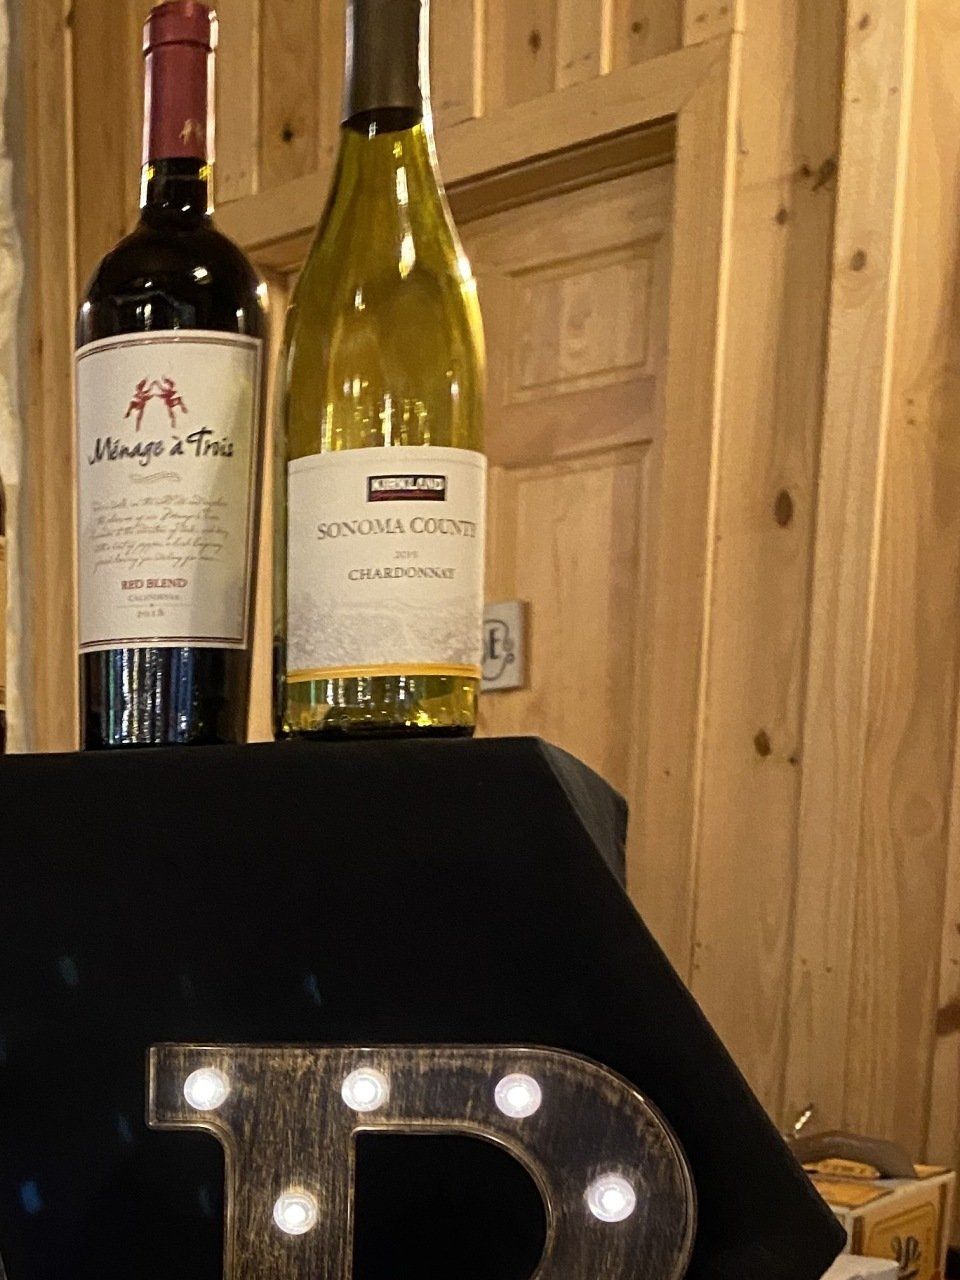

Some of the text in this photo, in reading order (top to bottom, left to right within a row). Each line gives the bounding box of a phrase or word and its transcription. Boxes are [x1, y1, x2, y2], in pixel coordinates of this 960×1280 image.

[88, 426, 235, 467] Ménage à Trois
[371, 477, 444, 492] KIRKLAND
[317, 518, 406, 541] SONOMA
[347, 566, 456, 581] CHARDONNAY
[121, 577, 189, 590] RED BLEND
